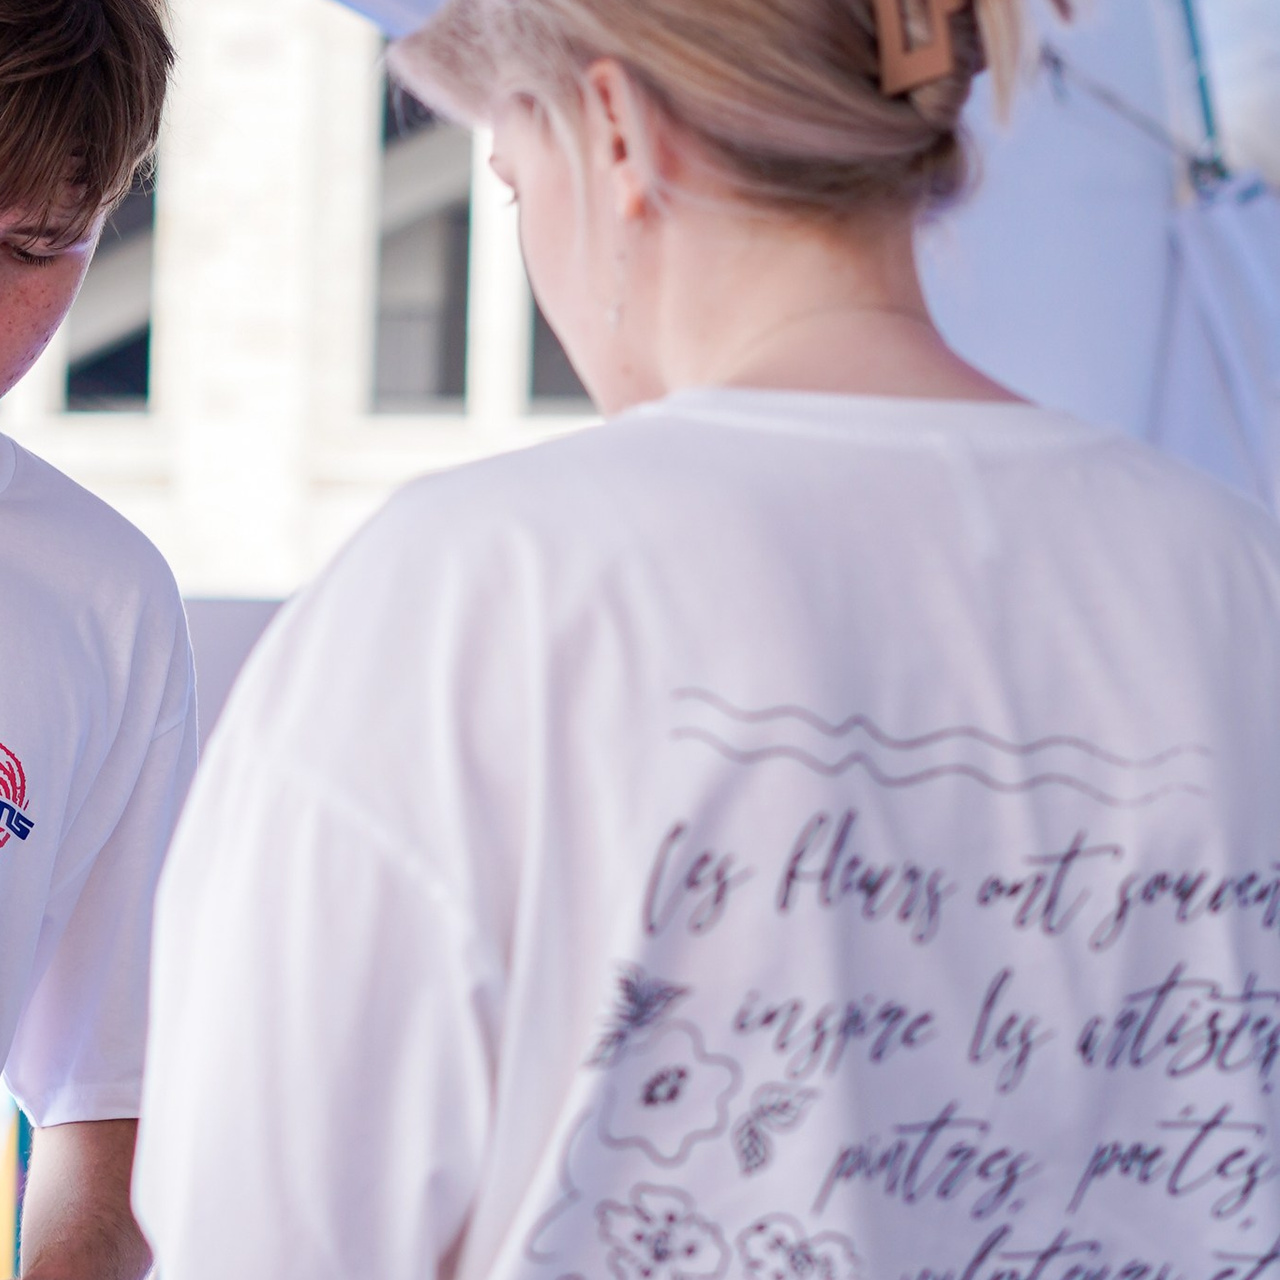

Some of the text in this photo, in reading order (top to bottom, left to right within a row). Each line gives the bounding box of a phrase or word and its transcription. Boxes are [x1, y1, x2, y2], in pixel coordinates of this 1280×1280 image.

[774, 808, 958, 947] fleurs
[977, 828, 1122, 934] ont
[1089, 862, 1280, 952] souven
